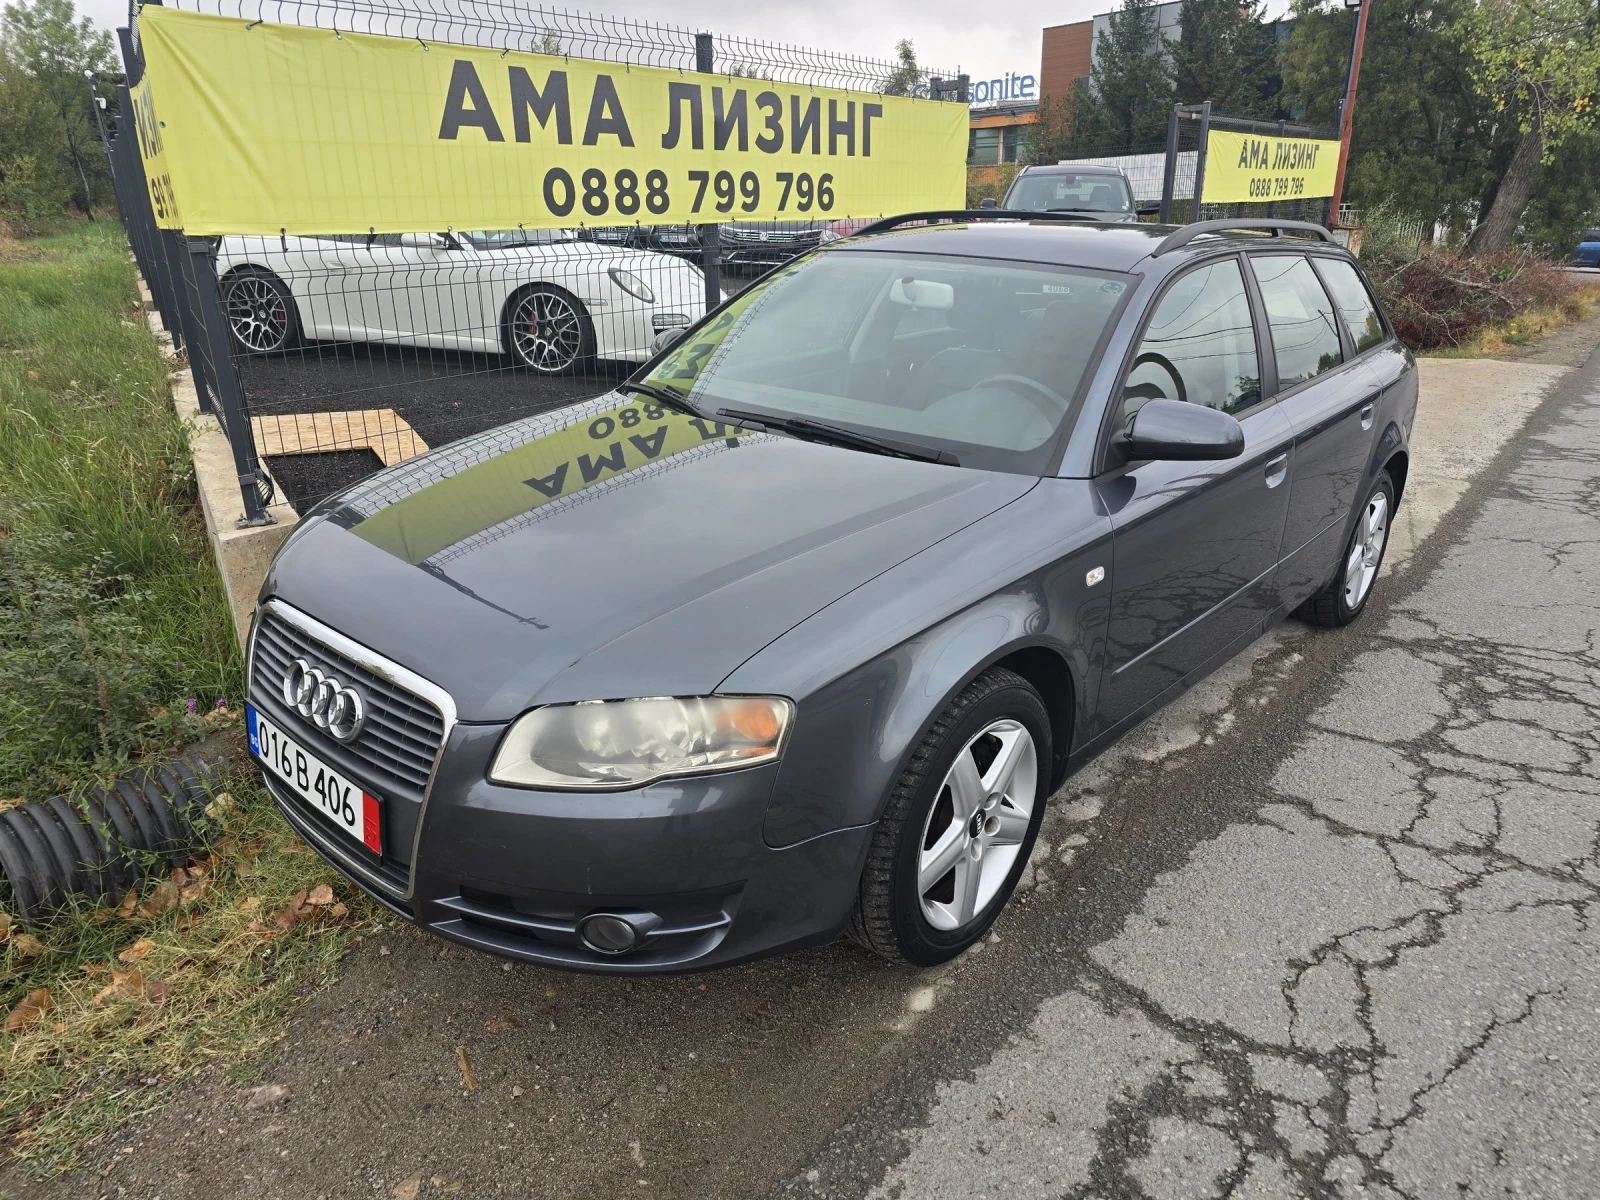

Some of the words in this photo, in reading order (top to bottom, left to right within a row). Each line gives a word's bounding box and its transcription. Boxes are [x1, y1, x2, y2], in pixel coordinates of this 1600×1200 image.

[438, 59, 635, 148] АМА
[661, 81, 883, 157] ЛИЗИНГ
[1238, 139, 1268, 170] АМА
[1272, 142, 1320, 170] ЛИЗИНГ
[542, 166, 671, 217] 0888
[687, 169, 761, 213] 799
[775, 171, 835, 212] 796
[1249, 178, 1271, 197] 0888
[1273, 177, 1289, 196] 799
[1290, 176, 1304, 195] 796
